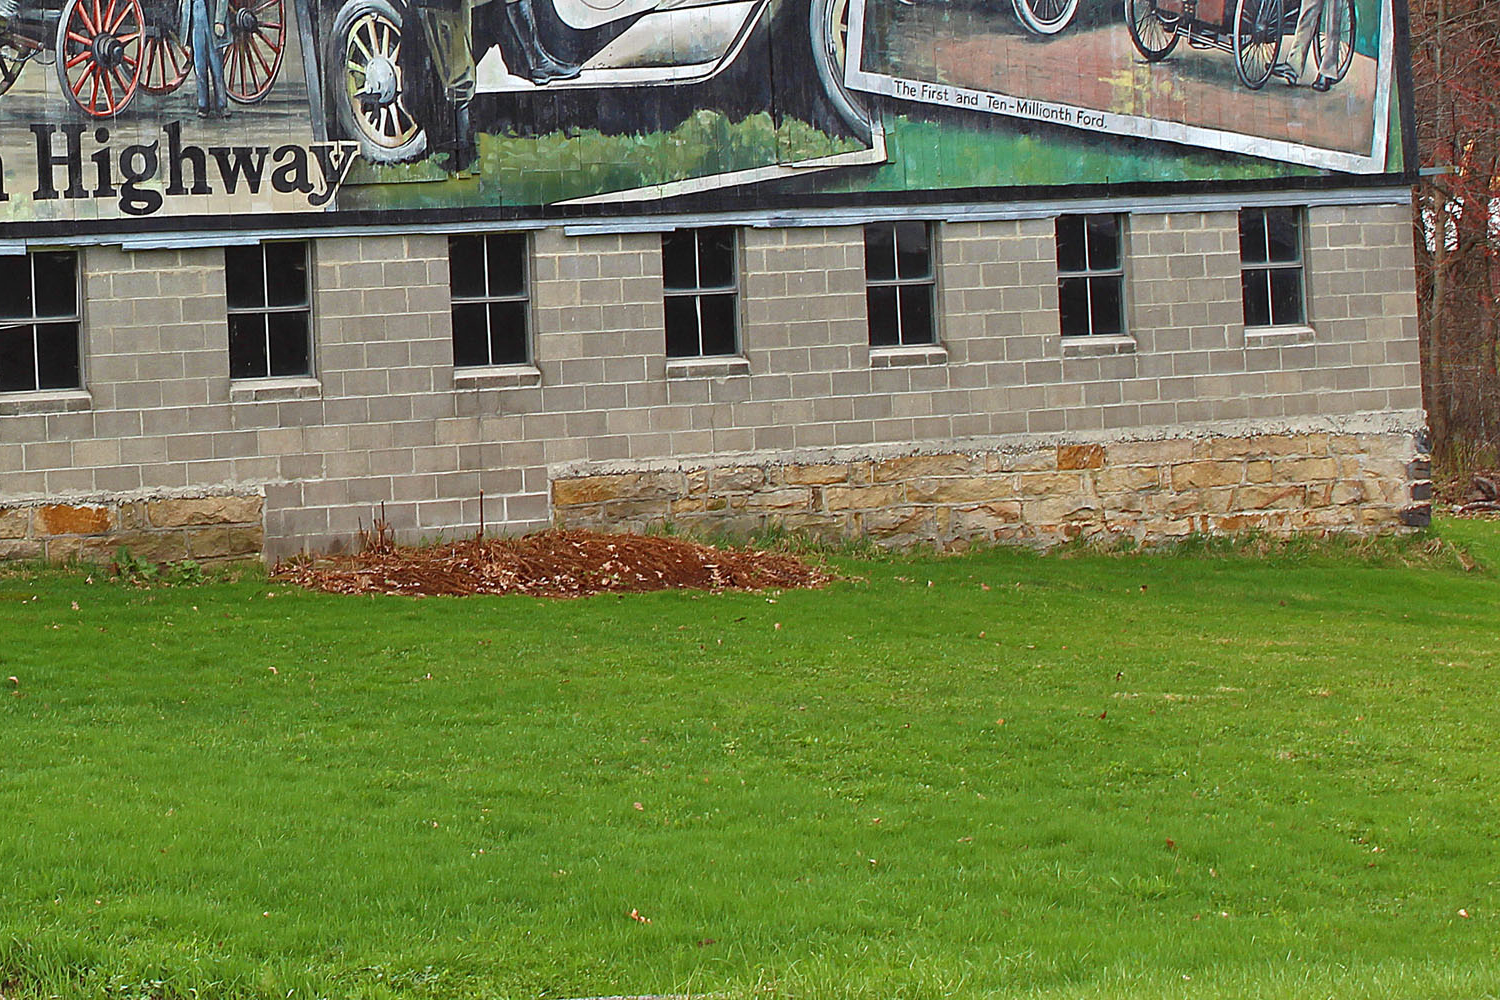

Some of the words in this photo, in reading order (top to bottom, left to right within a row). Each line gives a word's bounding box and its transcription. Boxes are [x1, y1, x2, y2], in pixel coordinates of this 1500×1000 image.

[894, 80, 917, 97] The
[921, 85, 949, 101] First
[956, 90, 978, 106] and
[986, 94, 1072, 122] Ten-Millionth
[31, 122, 360, 215] Highway
